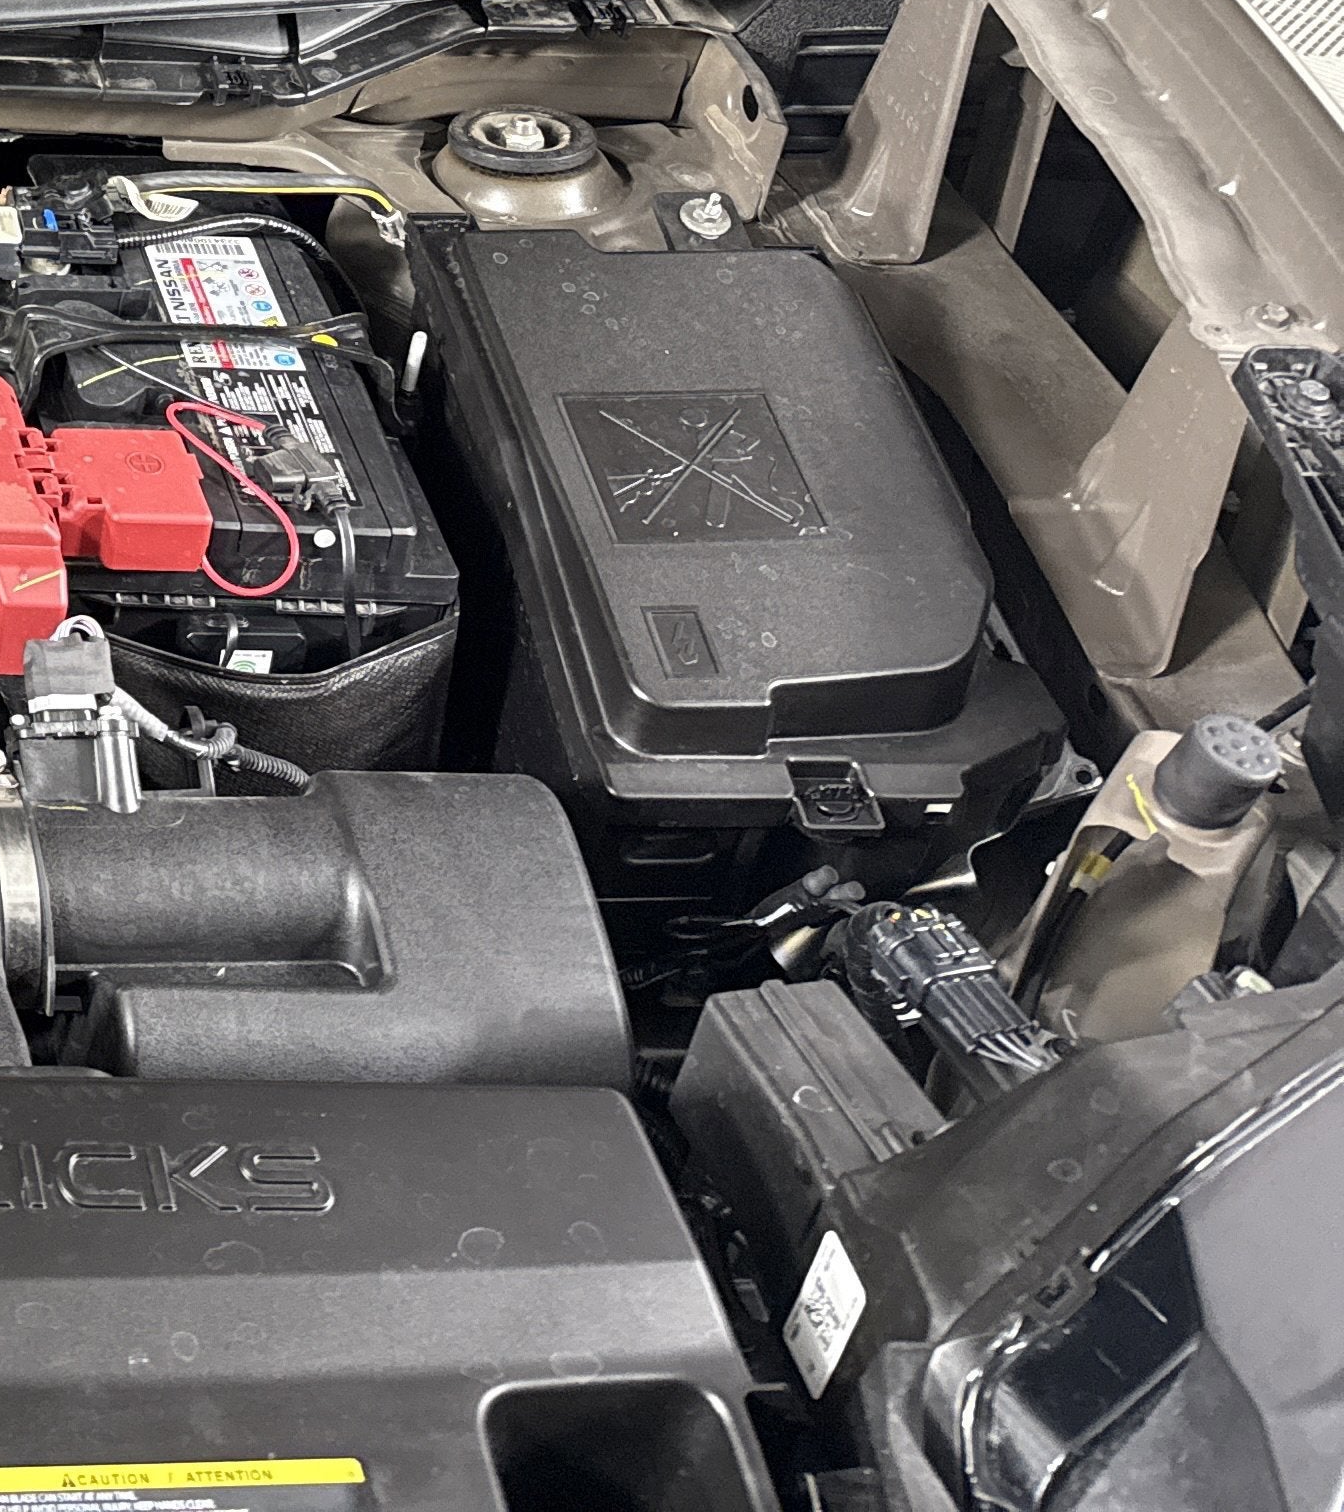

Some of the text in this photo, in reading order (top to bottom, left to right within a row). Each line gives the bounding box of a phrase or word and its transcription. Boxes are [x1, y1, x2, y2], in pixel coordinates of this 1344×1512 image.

[156, 259, 188, 311] NISSAN
[78, 1472, 150, 1486] CAUTION
[186, 1469, 273, 1482] ATTENTION
